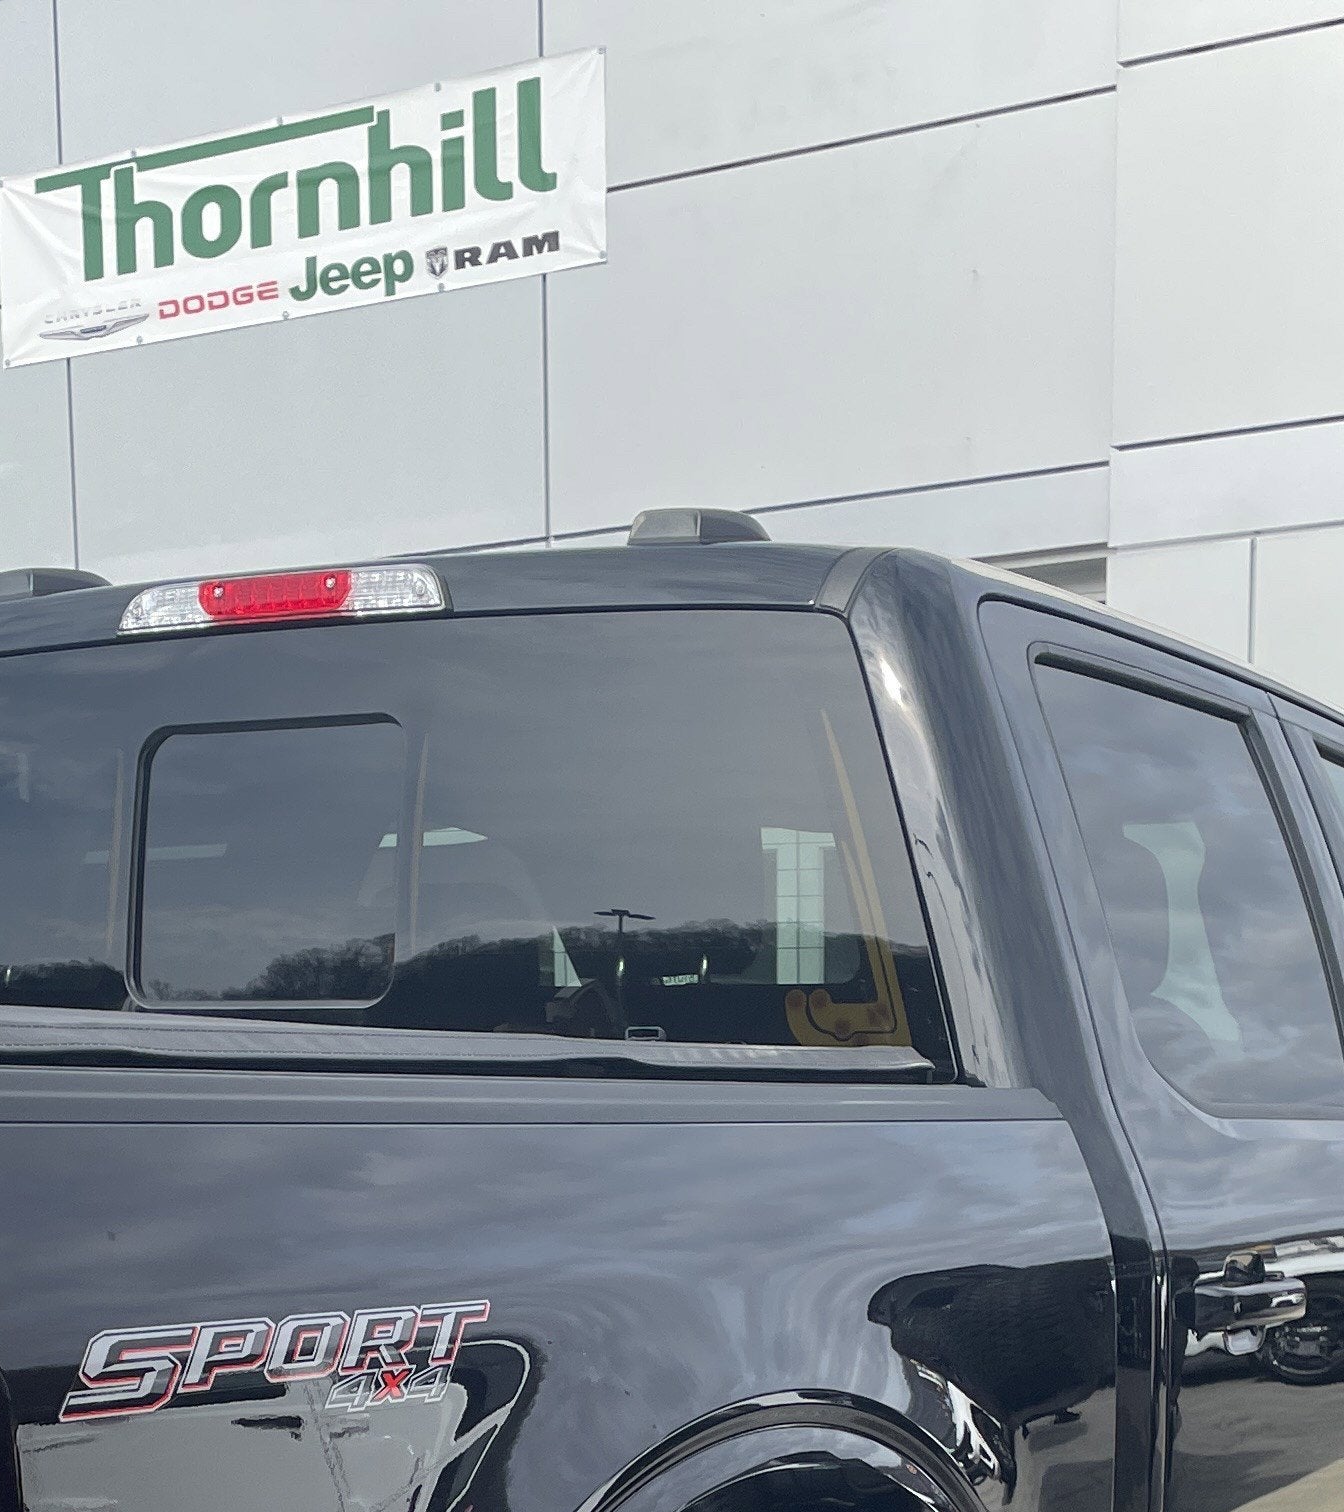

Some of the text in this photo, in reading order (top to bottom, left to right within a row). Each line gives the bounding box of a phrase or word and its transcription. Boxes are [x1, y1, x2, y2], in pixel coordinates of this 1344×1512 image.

[34, 76, 557, 282] Thornhill
[158, 280, 279, 320] DODGE
[289, 249, 415, 301] Jeep
[453, 230, 560, 270] RAM
[59, 1299, 490, 1423] SPORT
